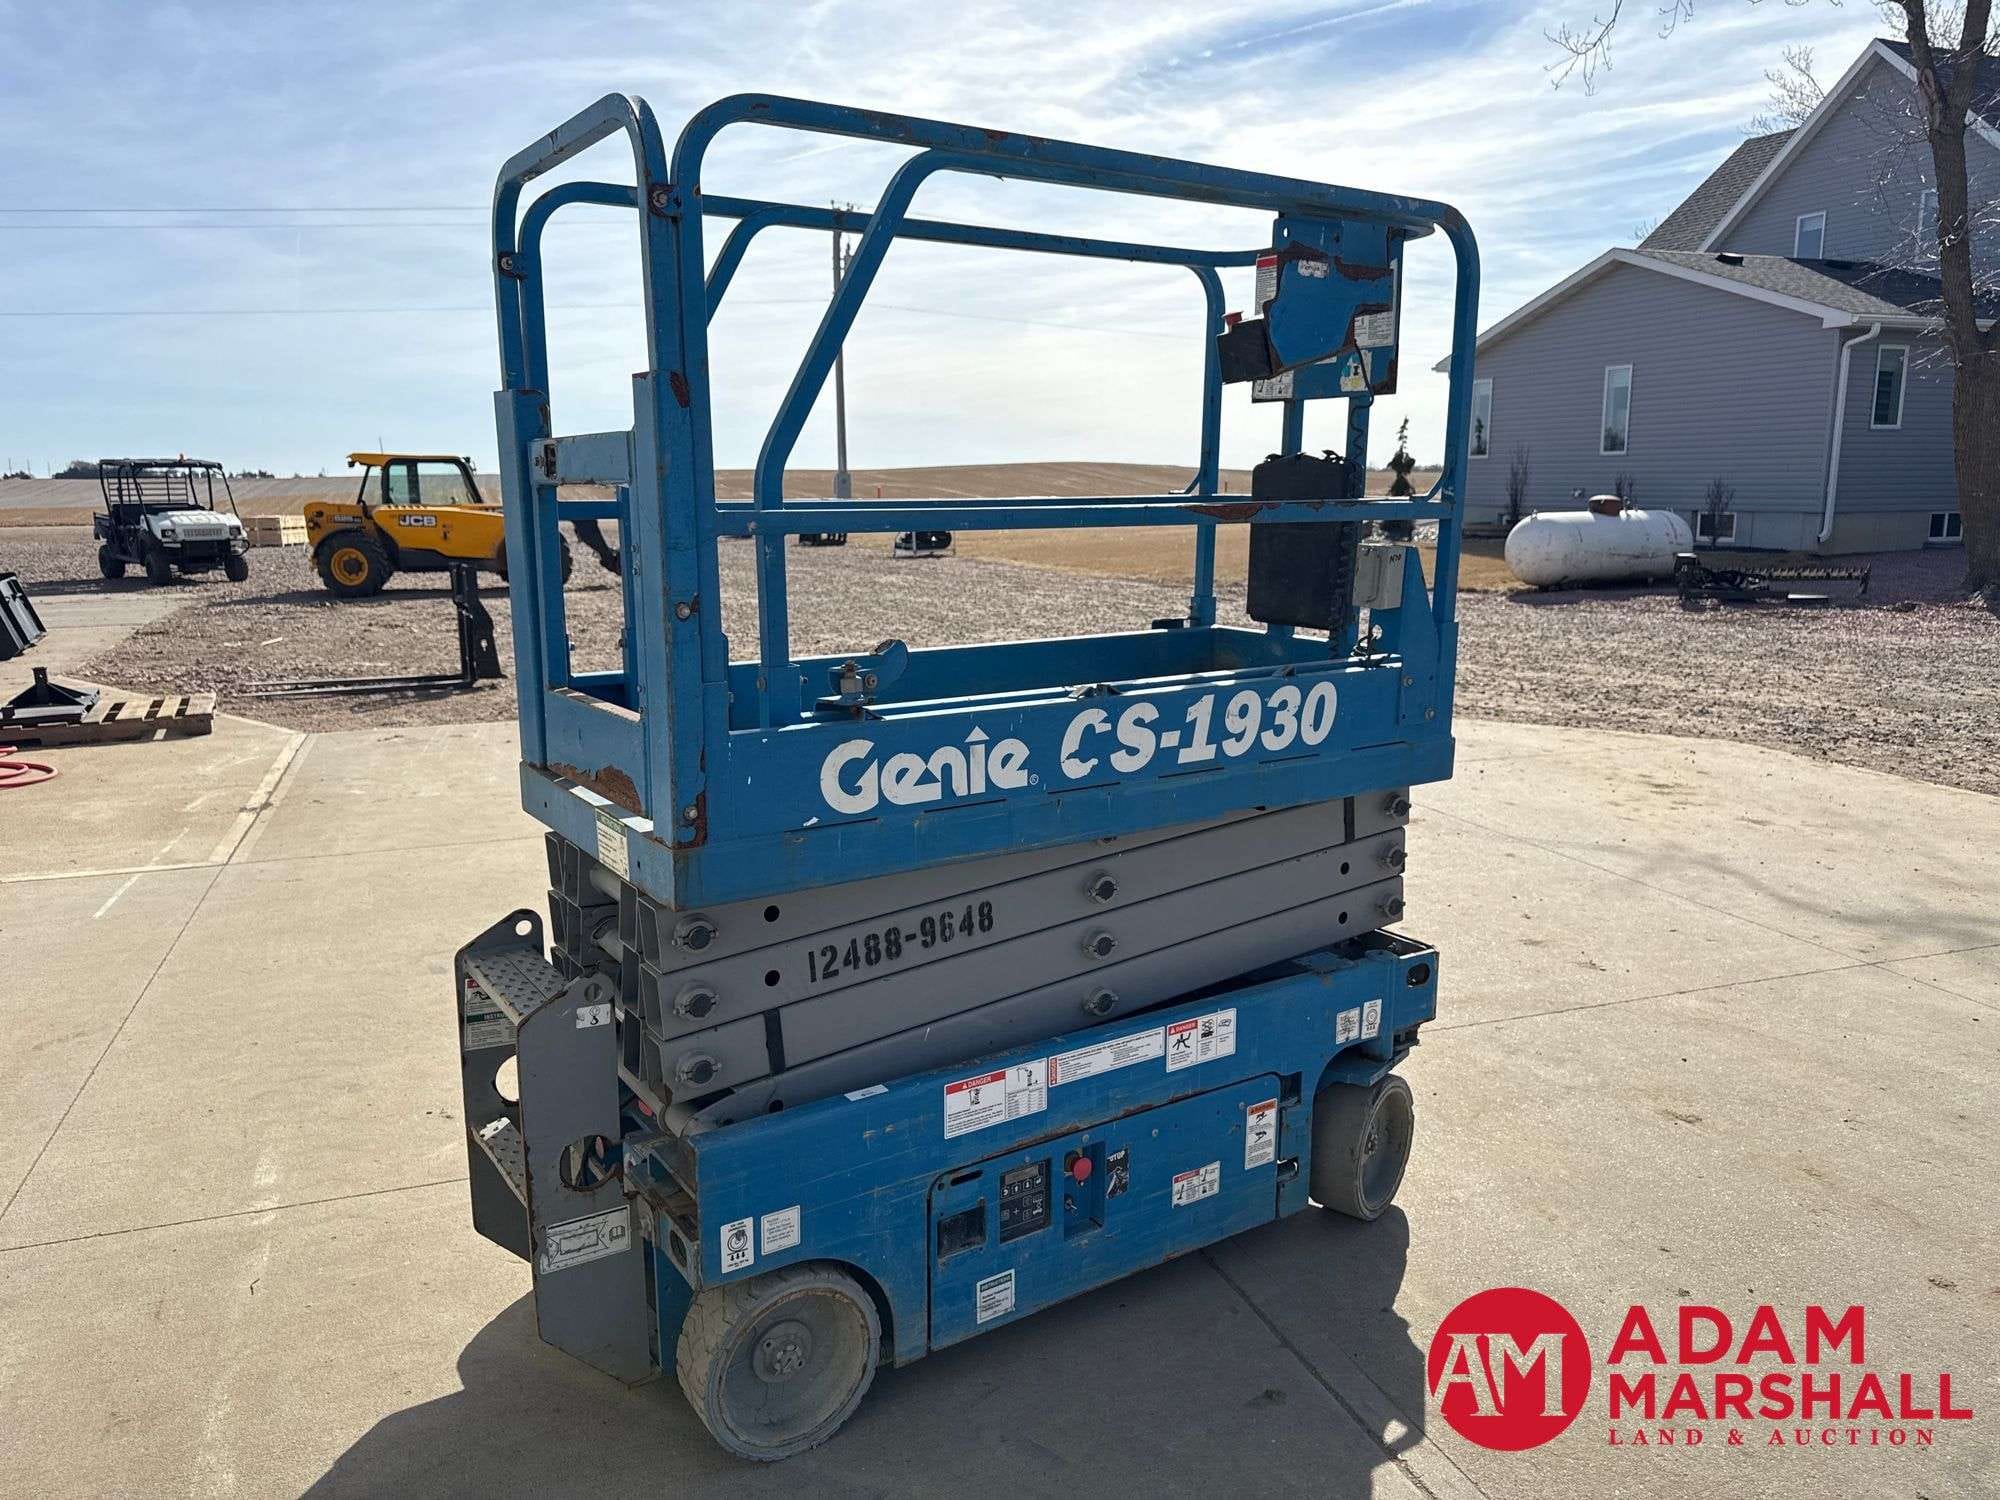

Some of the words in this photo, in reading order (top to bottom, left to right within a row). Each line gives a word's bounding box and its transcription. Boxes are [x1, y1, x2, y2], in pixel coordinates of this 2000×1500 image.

[400, 516, 436, 526] JCB
[820, 725, 1030, 814] Genie
[1060, 680, 1338, 780] CS-1930
[808, 900, 994, 983] 12488-9648
[968, 1076, 992, 1088] DANGER
